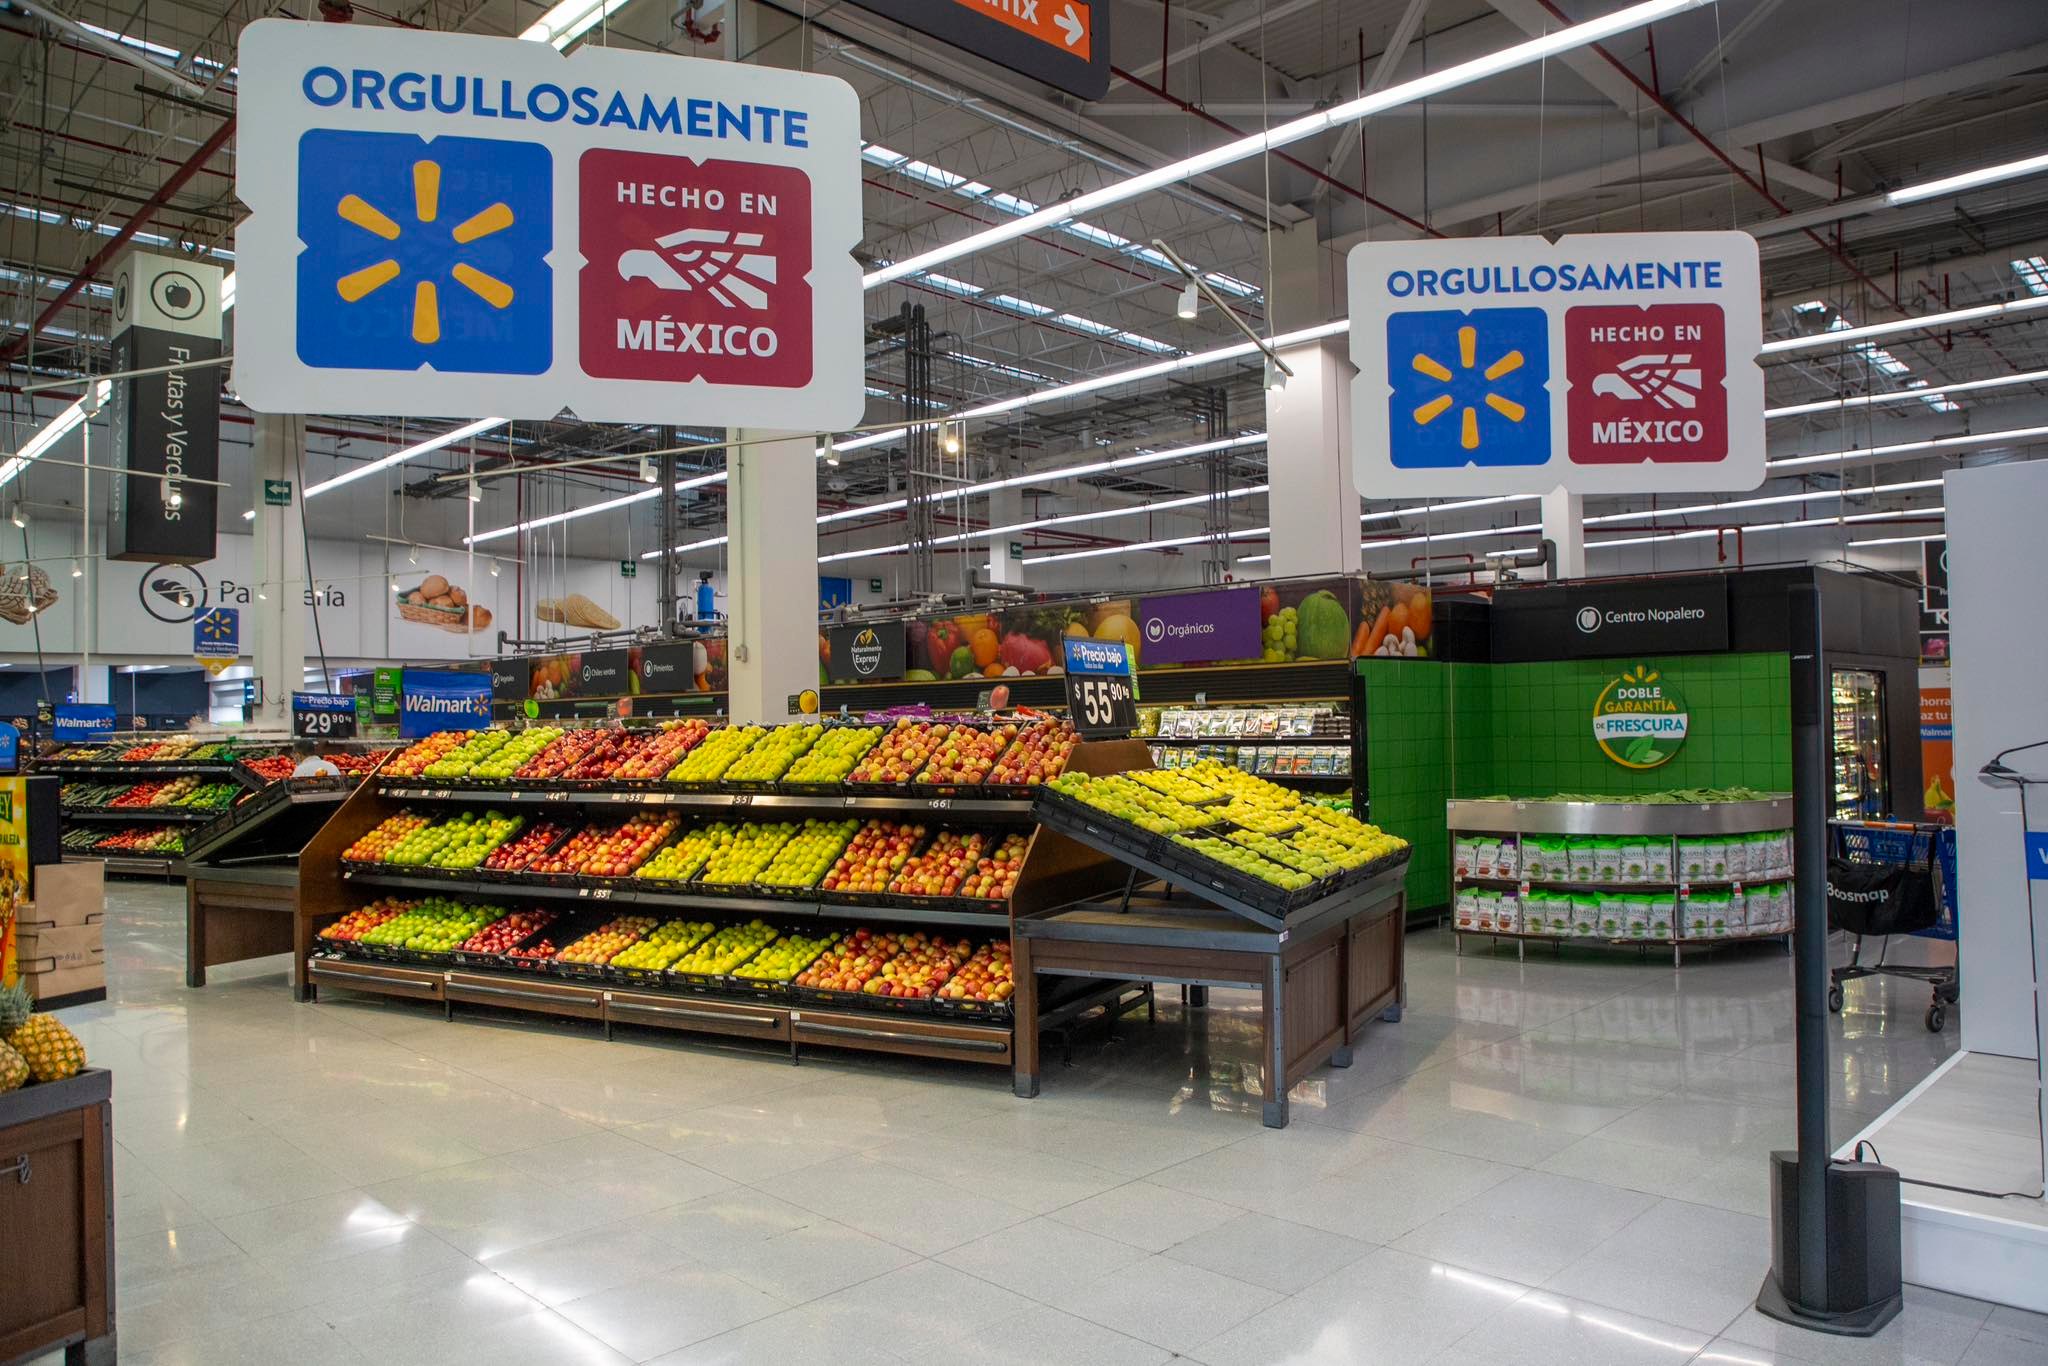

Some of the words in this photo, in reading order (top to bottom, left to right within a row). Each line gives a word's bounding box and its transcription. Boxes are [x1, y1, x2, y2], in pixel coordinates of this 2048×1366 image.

[301, 65, 809, 149] ORGULLOSAMENTE
[617, 182, 725, 212] HECHO
[740, 192, 778, 216] EN
[1387, 261, 1723, 298] ORGULLOSAMENTE
[616, 314, 778, 358] MÉXICO
[1590, 326, 1665, 343] HECHO
[1674, 325, 1702, 341] EN
[161, 412, 183, 427] y
[1592, 417, 1703, 444] MÉXICO
[164, 430, 188, 521] Verduas
[1605, 611, 1645, 624] Centro
[1648, 607, 1705, 623] Nopalero
[1167, 622, 1214, 638] Orgánicos
[855, 654, 879, 665] Express
[1081, 644, 1106, 662] Precio
[1106, 646, 1122, 668] bajo
[308, 696, 330, 706] Precio
[333, 697, 349, 708] bajo
[1618, 687, 1661, 699] DOBLE
[1919, 696, 1951, 706] horra
[405, 694, 472, 713] Walmart
[1084, 681, 1112, 725] 55
[1605, 697, 1677, 713] GARANTÍA
[56, 717, 101, 728] Walmart
[305, 713, 332, 734] 29
[1606, 719, 1685, 733] FRESCURA
[1920, 728, 1952, 737] Walmar
[1827, 882, 1889, 903] Boosmap
